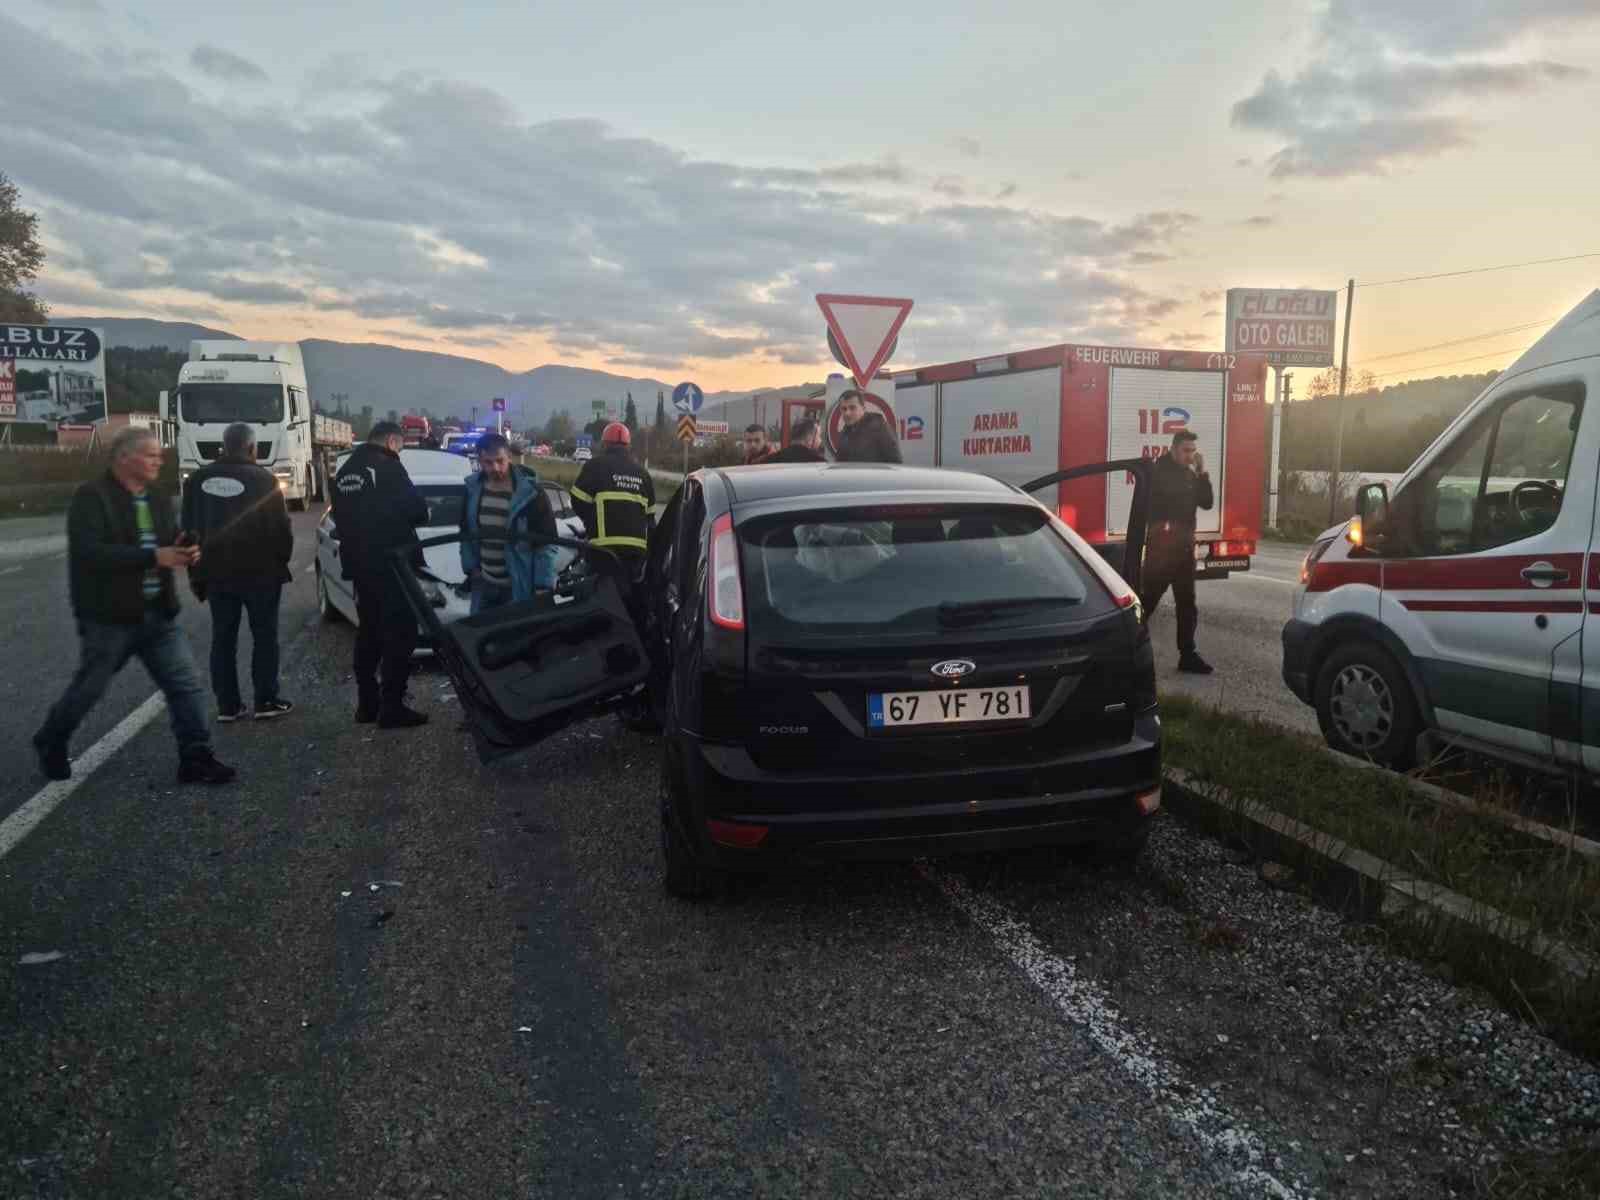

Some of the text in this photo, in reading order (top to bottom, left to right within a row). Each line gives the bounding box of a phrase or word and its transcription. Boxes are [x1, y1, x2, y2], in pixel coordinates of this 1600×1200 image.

[0, 327, 87, 346] BUZ
[1239, 322, 1270, 345] OTO
[1076, 347, 1160, 366] FEUERWEHR
[974, 411, 1018, 431] ARAMA
[1139, 407, 1191, 434] 112
[963, 435, 1032, 456] KURTARMA
[890, 690, 1024, 721] 67 YF 781
[759, 725, 809, 735] FOCUS
